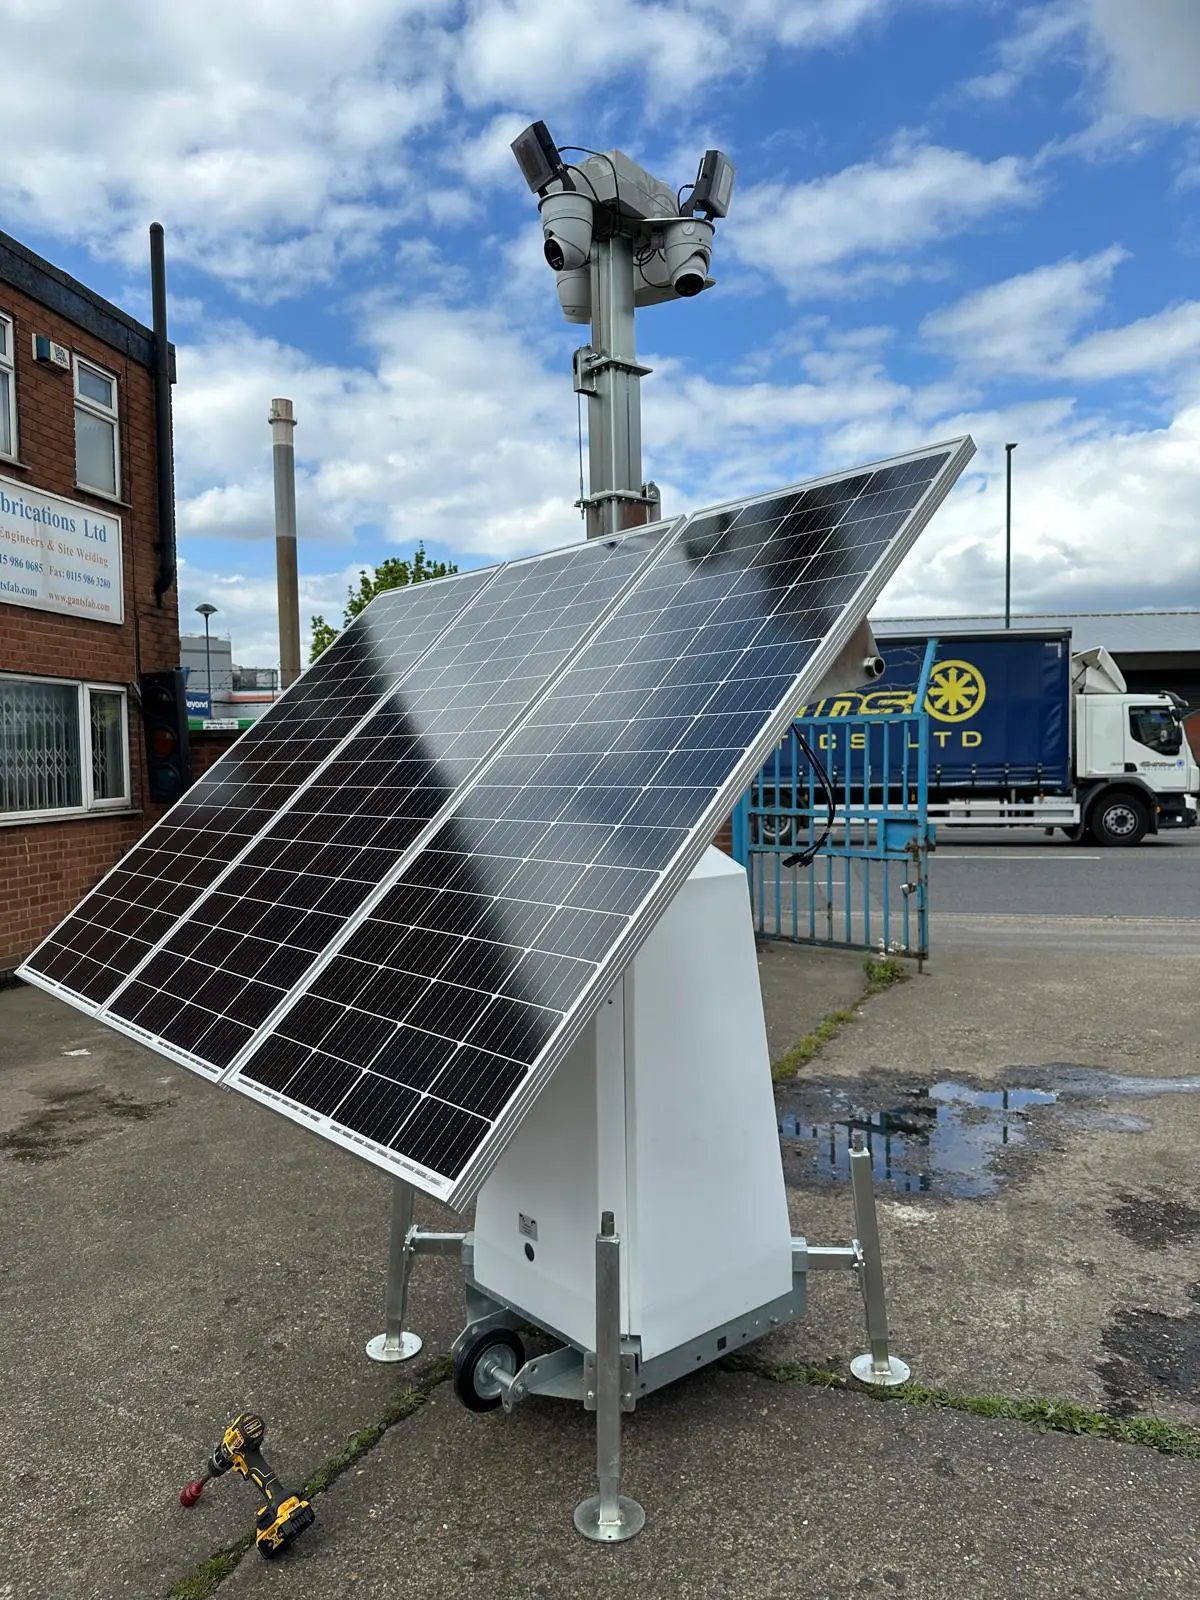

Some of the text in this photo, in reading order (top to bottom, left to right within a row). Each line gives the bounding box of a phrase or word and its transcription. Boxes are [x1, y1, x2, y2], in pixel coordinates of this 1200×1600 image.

[83, 518, 107, 543] Ltd
[0, 526, 109, 568] Engineers & Site Welding
[9, 556, 24, 569] 986
[25, 559, 43, 573] 0685
[49, 565, 65, 578] Fax:
[66, 569, 82, 583] 0115
[83, 574, 95, 585] 986
[48, 591, 111, 611] www.gantsfab.com
[907, 731, 982, 748] LTD
